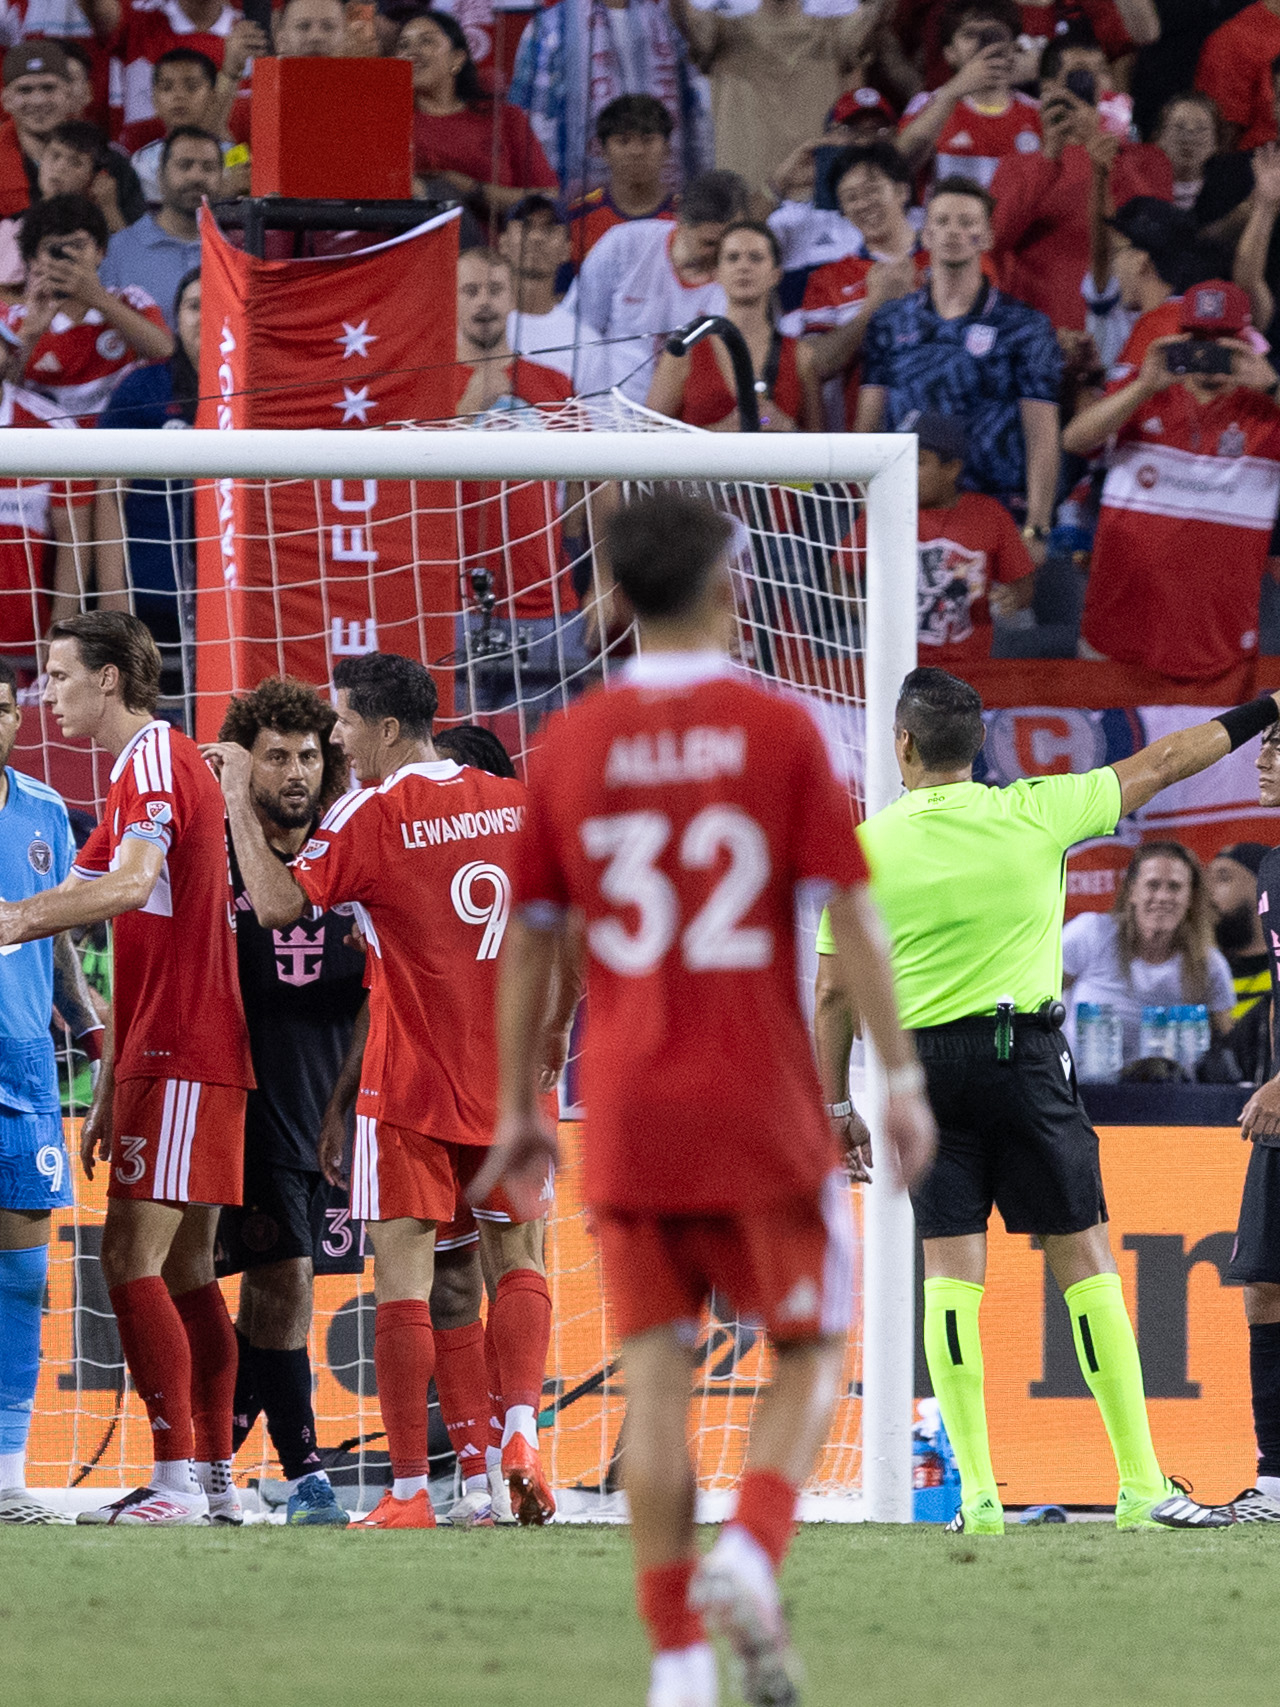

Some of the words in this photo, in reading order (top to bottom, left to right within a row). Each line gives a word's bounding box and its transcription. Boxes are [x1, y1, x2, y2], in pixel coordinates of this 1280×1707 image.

[401, 806, 527, 849] LEWANDOWSK
[450, 860, 513, 961] 9
[584, 803, 774, 978] 32
[115, 1135, 147, 1185] 3
[322, 1208, 366, 1258] 3
[446, 1417, 476, 1431] FIRE
